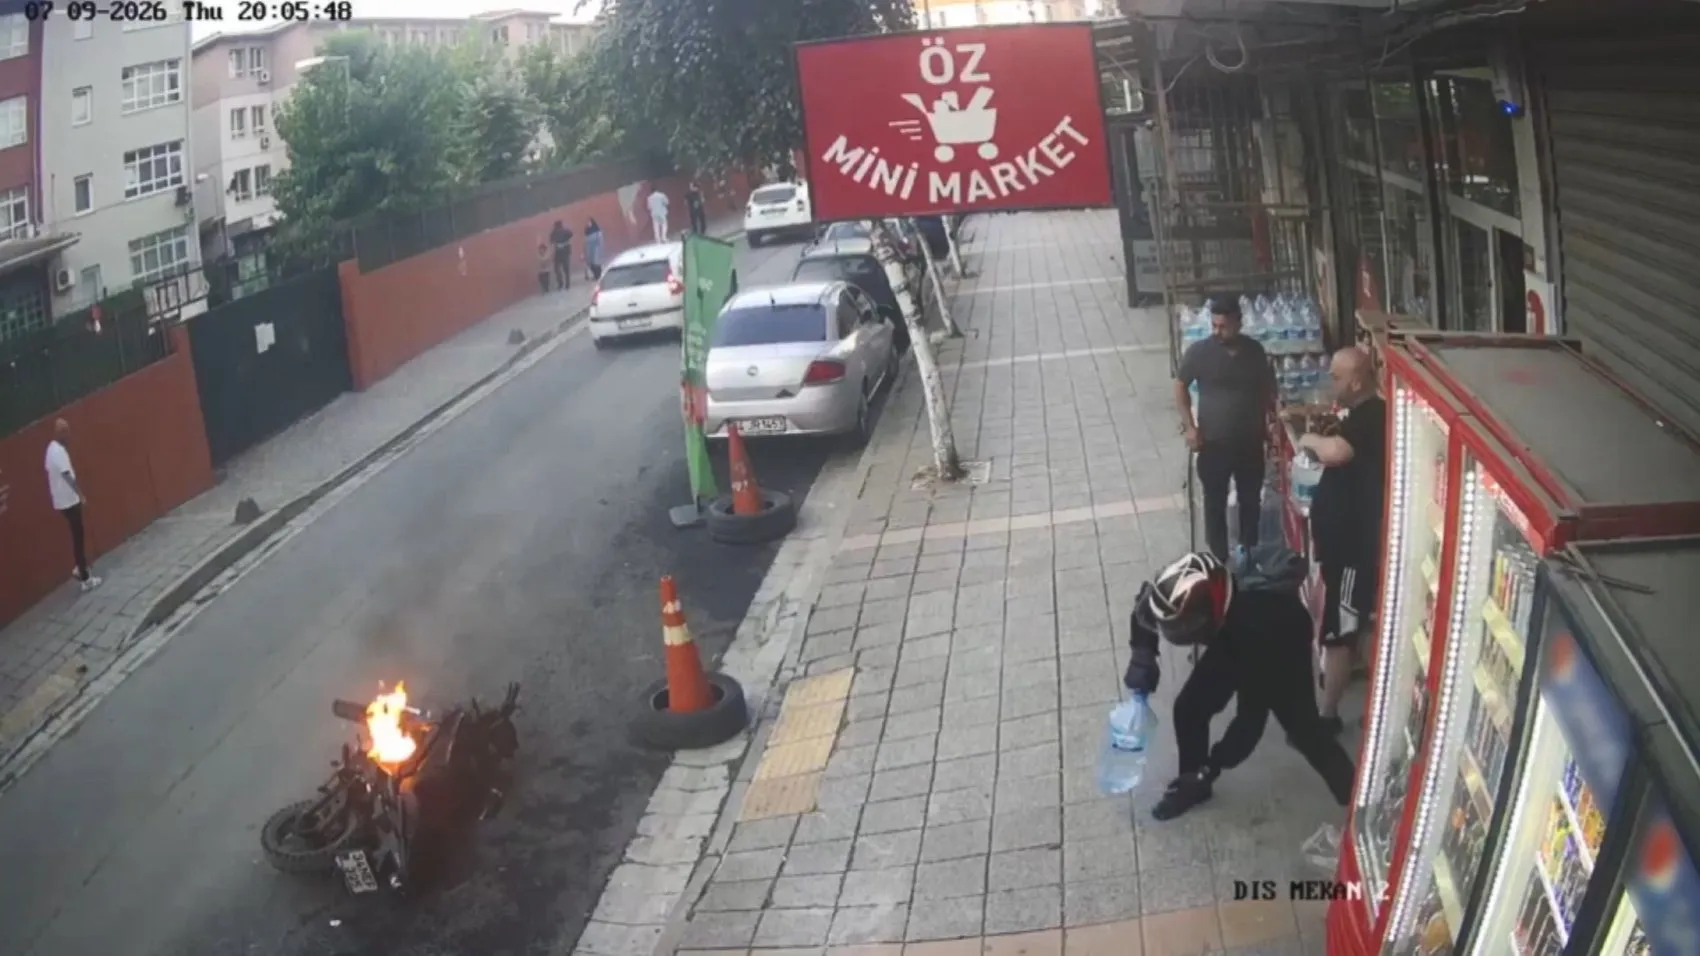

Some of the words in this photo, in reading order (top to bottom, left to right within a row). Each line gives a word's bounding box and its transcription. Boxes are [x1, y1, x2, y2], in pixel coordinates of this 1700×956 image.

[919, 37, 991, 85] ÖZ
[822, 135, 919, 200] MİNİ
[929, 115, 1089, 204] MARKET
